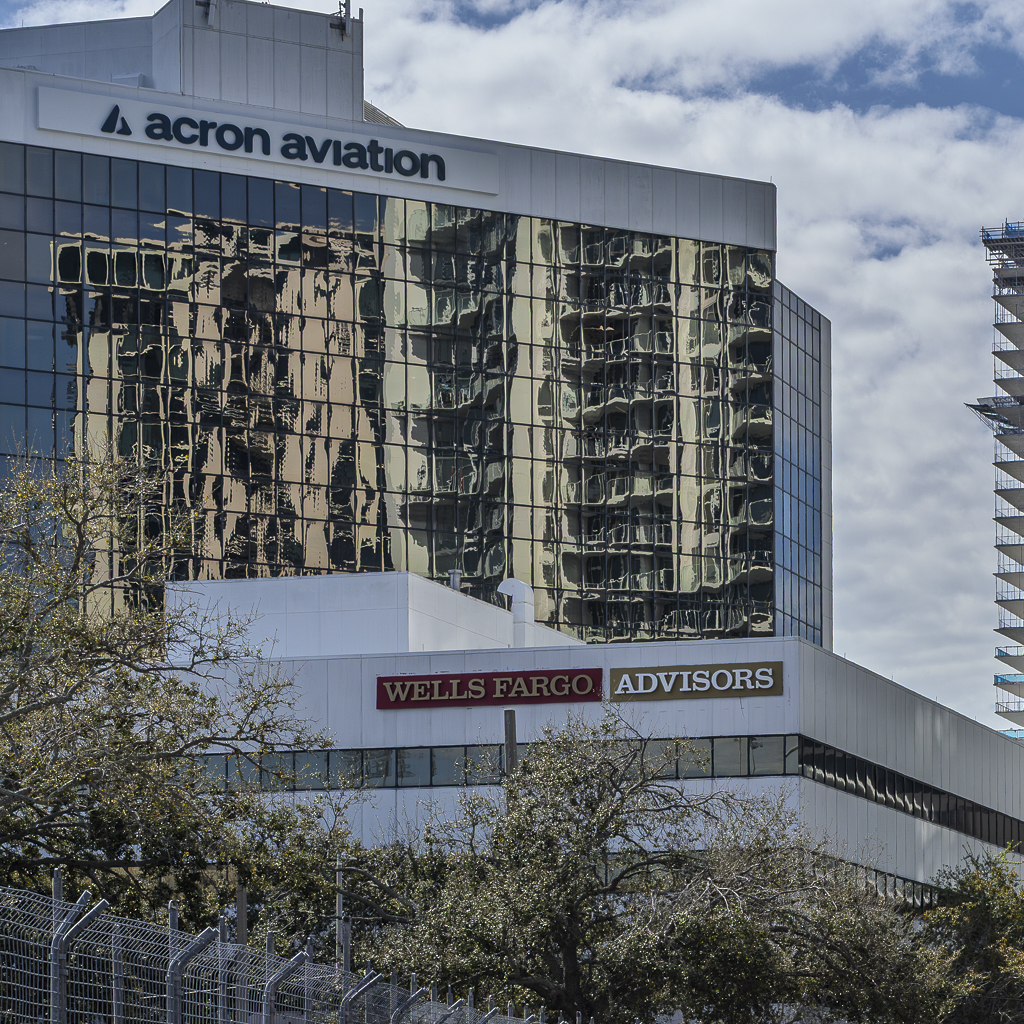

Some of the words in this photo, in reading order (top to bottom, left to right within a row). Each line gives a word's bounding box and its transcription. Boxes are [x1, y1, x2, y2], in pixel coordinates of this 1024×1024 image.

[145, 112, 271, 156] acron
[281, 132, 446, 181] aviation
[383, 678, 486, 702] WELLS
[493, 674, 594, 698] FARGO
[615, 667, 774, 695] ADVISORS
